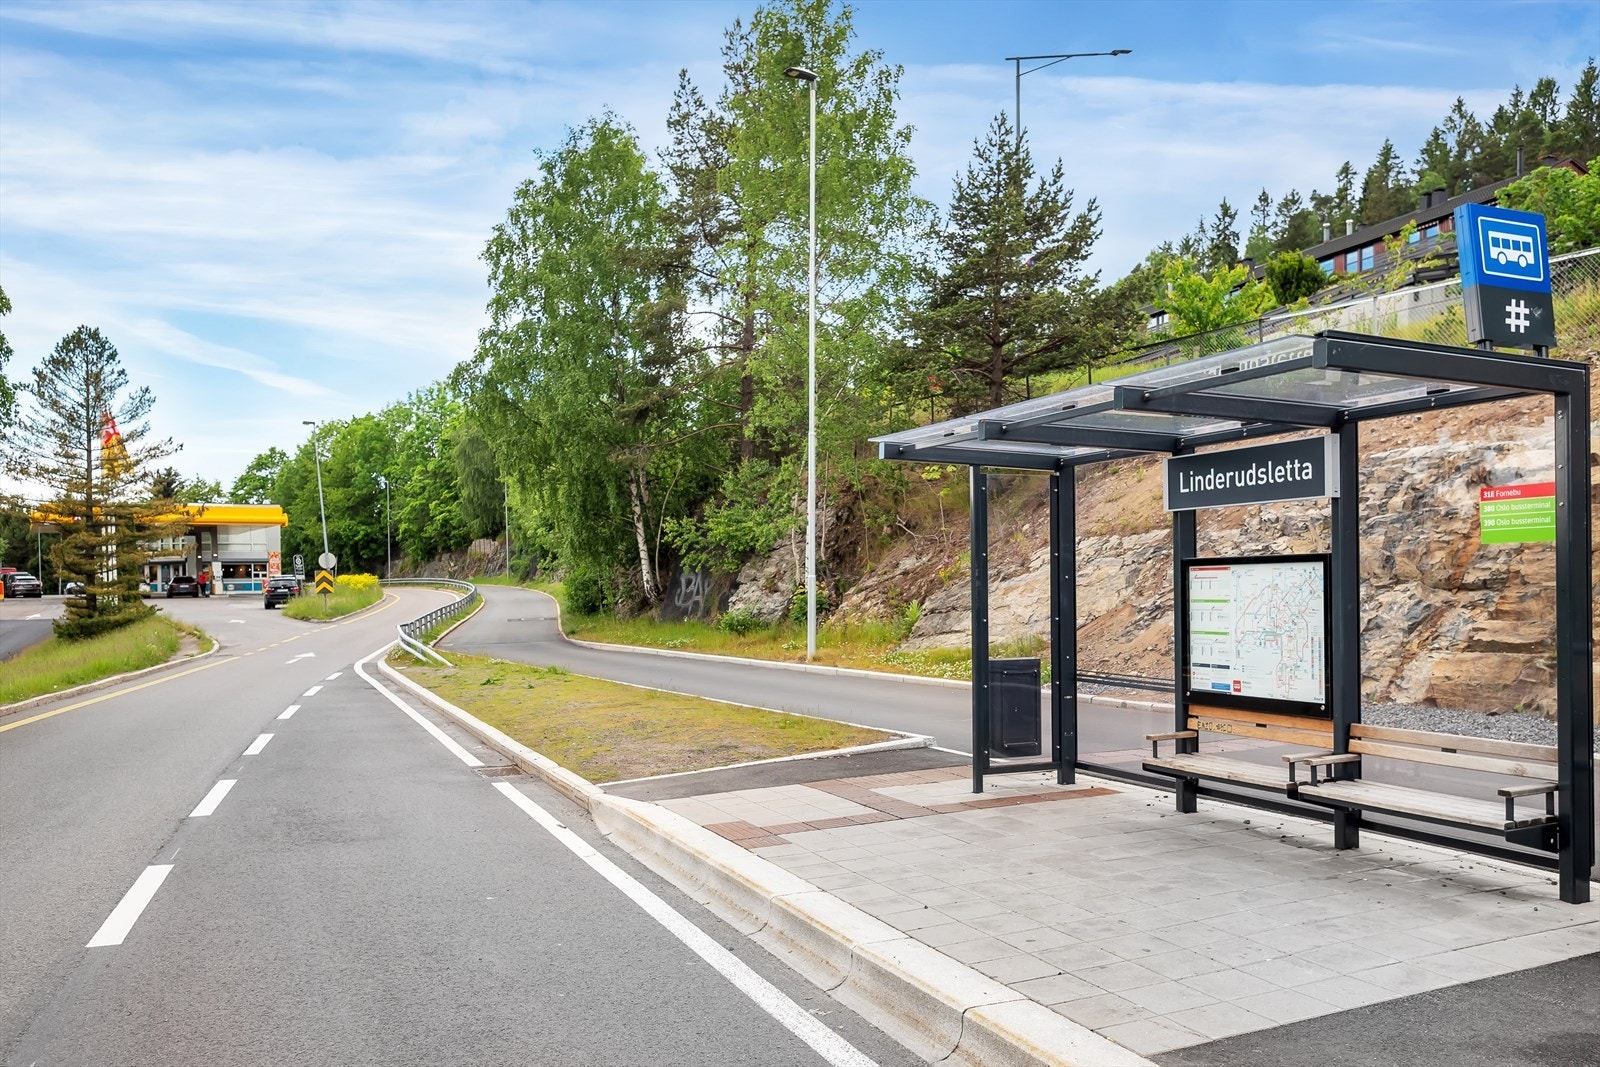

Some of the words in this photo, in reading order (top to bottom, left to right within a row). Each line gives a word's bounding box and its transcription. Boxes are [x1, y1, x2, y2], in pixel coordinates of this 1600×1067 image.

[1179, 459, 1313, 493] Linderudsletta
[1483, 490, 1495, 498] 31E
[1496, 489, 1521, 497] Fornebu
[1510, 501, 1551, 510] bussterminal
[1496, 518, 1510, 526] Oslo
[1511, 516, 1551, 525] bussterminal
